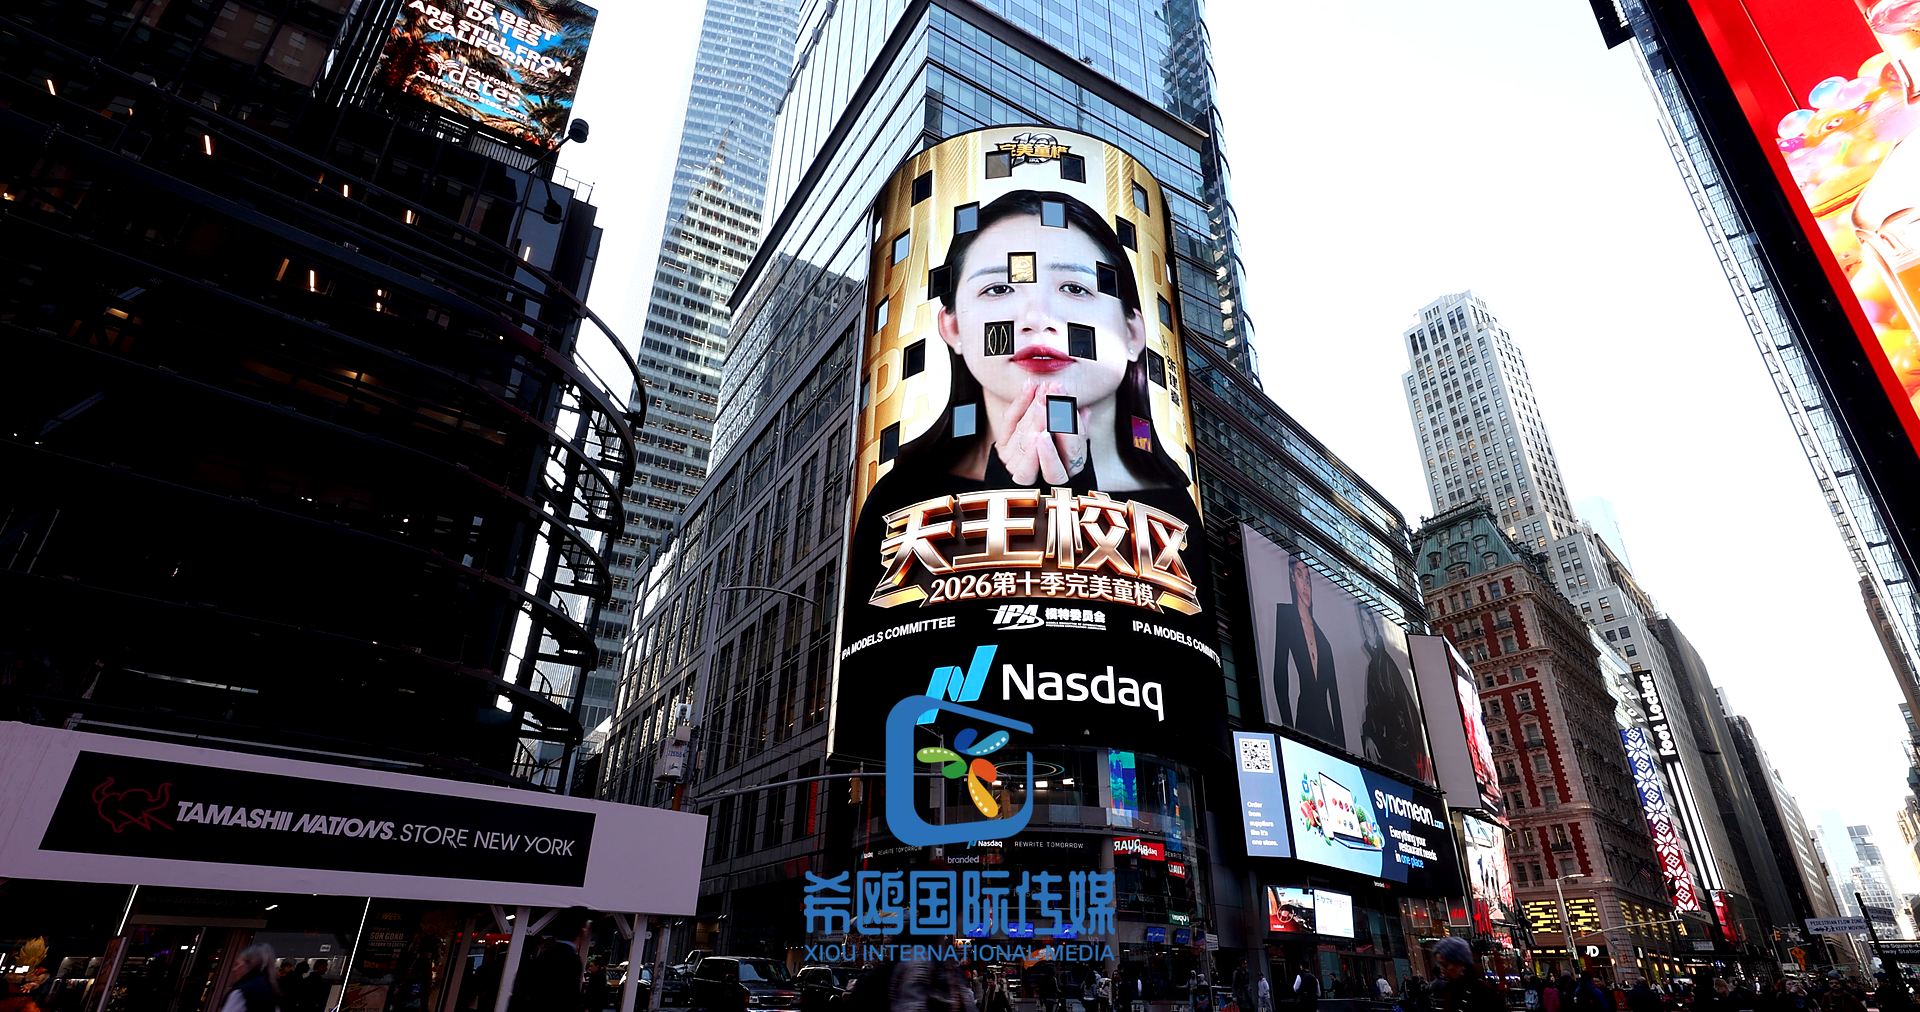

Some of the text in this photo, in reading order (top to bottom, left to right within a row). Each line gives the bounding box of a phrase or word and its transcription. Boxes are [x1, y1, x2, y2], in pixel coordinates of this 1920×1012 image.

[408, 0, 572, 76] ARE STILL FROM
[466, 7, 539, 47] DATES
[500, 10, 557, 40] BEST
[427, 18, 550, 78] CALIFORNIA
[416, 70, 528, 120] CaliforniaDates.com
[448, 66, 521, 107] dates
[469, 68, 522, 94] CALIFORNIA
[874, 488, 1197, 595] 天王校区
[930, 571, 1156, 609] 2026第十季完美童模
[991, 604, 1042, 626] IPA
[1132, 620, 1152, 634] IPA
[1153, 624, 1192, 647] MODELS
[851, 632, 884, 655] MODELS
[885, 616, 956, 640] COMMITTEE
[1002, 663, 1165, 722] Nasdaq
[1639, 673, 1677, 756] Foot Locker
[176, 801, 293, 831] TAMASHII
[400, 823, 469, 849] STORE
[474, 831, 521, 851] NEW
[524, 835, 575, 857] YORK
[1374, 789, 1445, 830] syncmeon.com
[947, 855, 980, 864] branded
[977, 839, 1003, 849] Nasdaq
[1047, 841, 1084, 849] TOMORROW
[1584, 945, 1600, 957] JD
